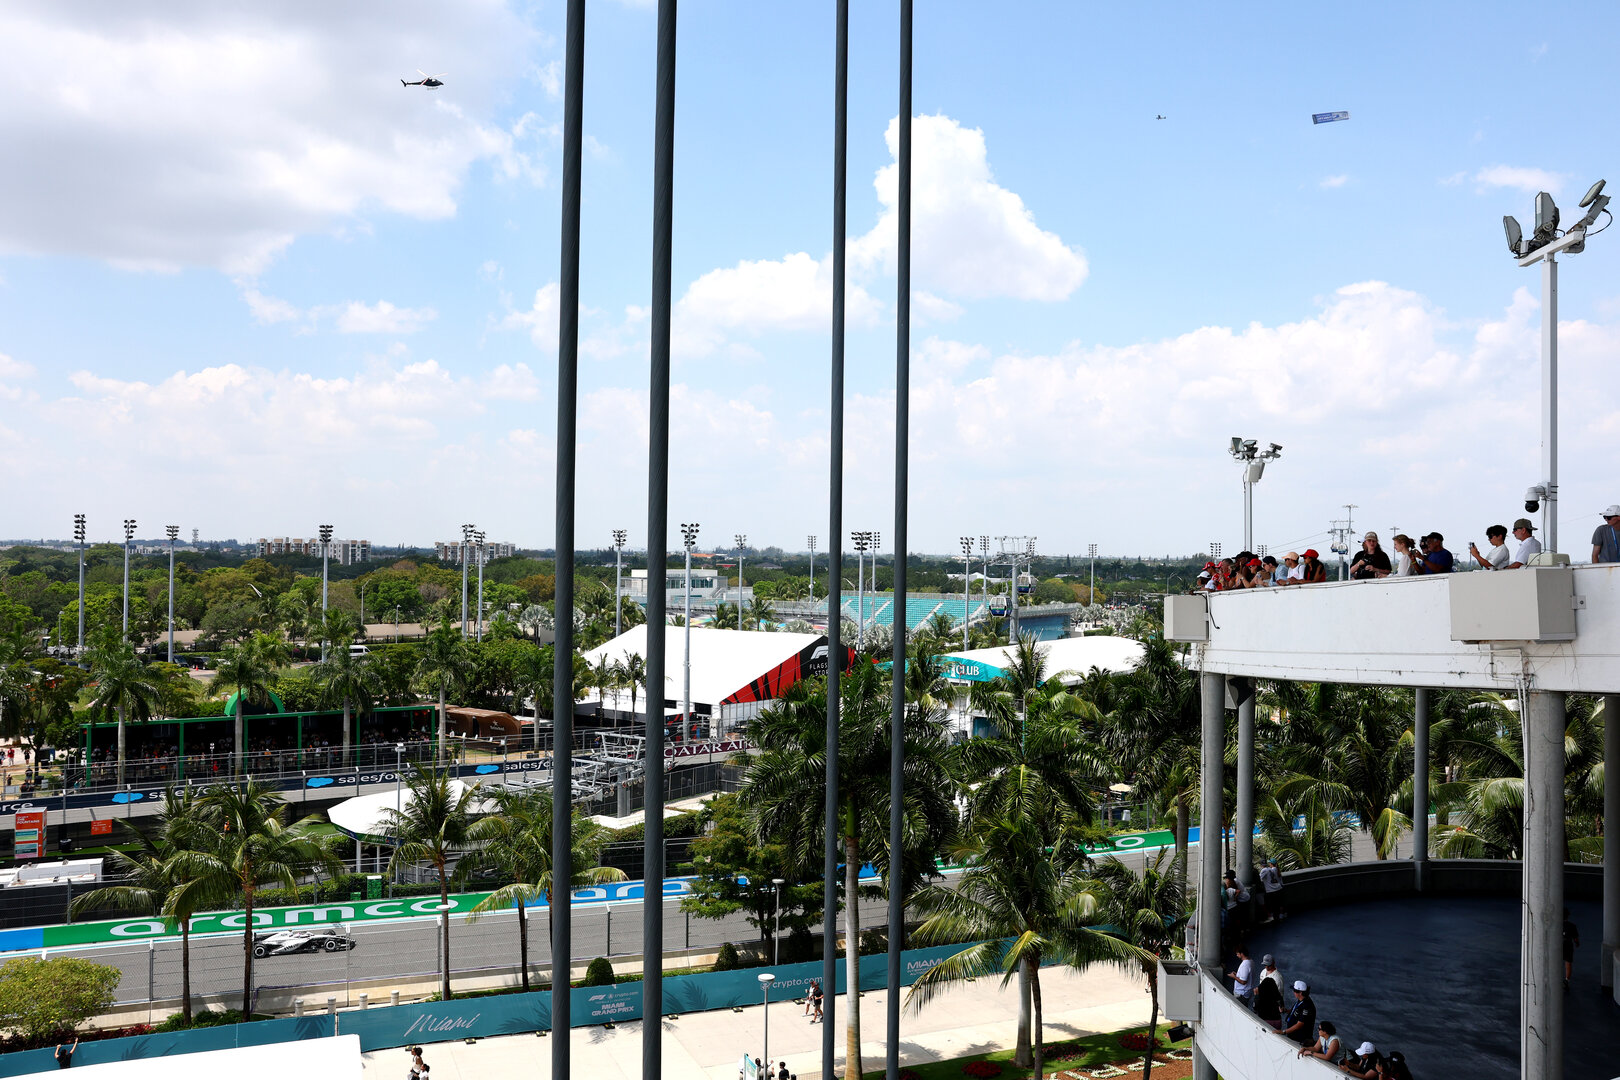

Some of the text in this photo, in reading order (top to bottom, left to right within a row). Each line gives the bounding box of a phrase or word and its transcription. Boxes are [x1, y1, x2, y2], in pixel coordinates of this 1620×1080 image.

[809, 662, 828, 670] FLAGS
[955, 664, 980, 676] CLUB
[814, 669, 829, 677] STOR
[109, 899, 459, 937] aramco
[906, 957, 943, 970] MIAMI
[772, 976, 823, 989] crypto.com
[601, 1002, 625, 1010] MIAMI
[617, 1006, 635, 1014] PRIX
[403, 1013, 481, 1037] Miami
